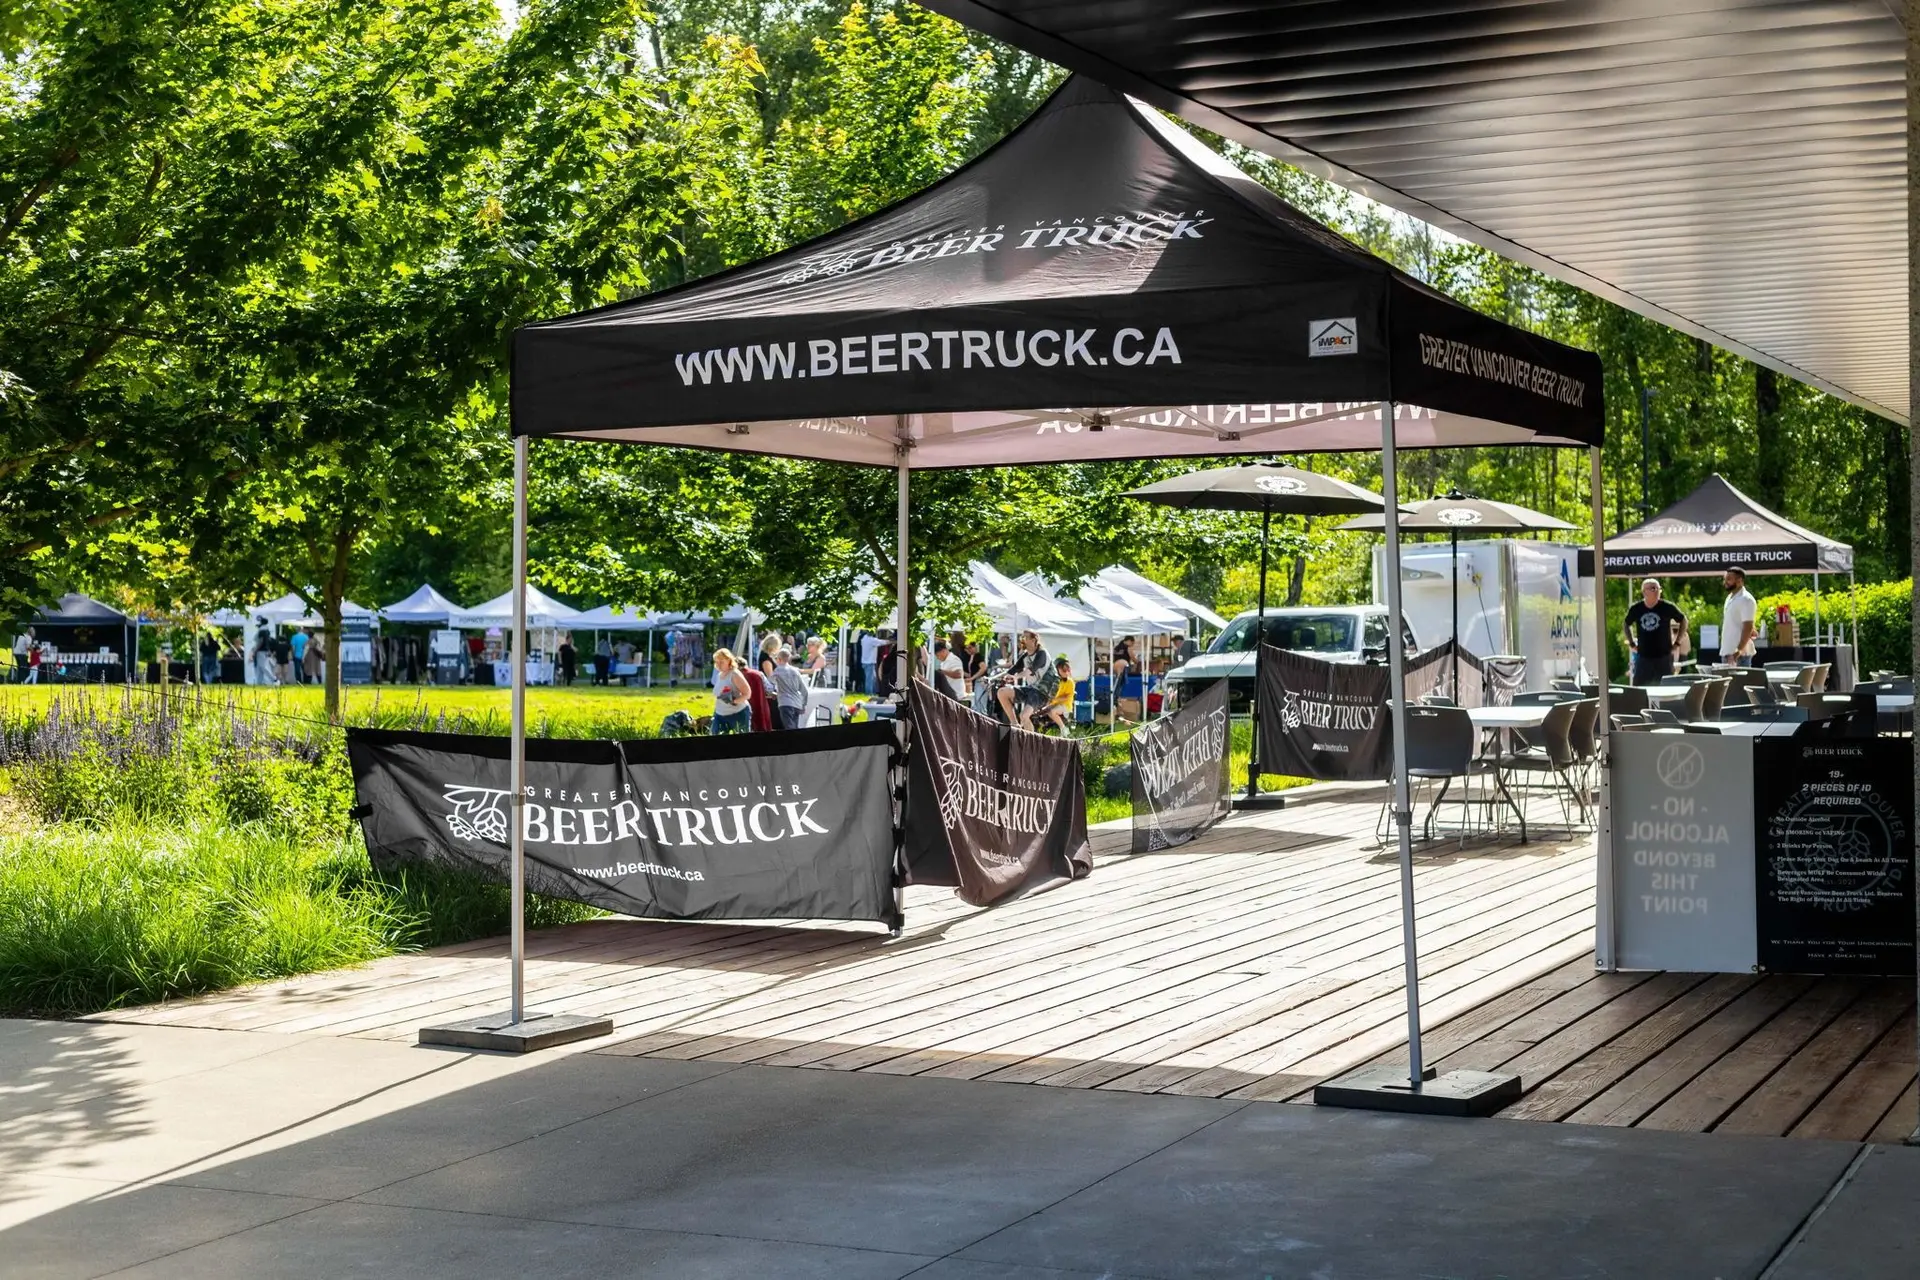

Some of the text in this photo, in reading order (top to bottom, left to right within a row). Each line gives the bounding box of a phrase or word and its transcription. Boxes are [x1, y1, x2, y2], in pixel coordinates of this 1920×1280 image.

[1035, 210, 1204, 227] VANCOUVER
[867, 217, 1215, 268] BEER TRUCK
[675, 327, 1182, 386] WWW.BEERTRUCK.CA
[1419, 333, 1585, 408] GREATER VANCOUVER BEER TRUCK
[1604, 551, 1792, 567] GREATER VANCOUVER BEER TRUCK
[1301, 700, 1332, 729] BEER
[1836, 748, 1864, 756] TRUCK
[1828, 770, 1844, 779] 19+
[526, 783, 802, 803] GREATER VANCOUVER
[1011, 777, 1050, 793] ANCOUVER
[1802, 783, 1872, 793] 2 PIECES OF ID
[1813, 796, 1862, 807] REQUIRED
[522, 798, 829, 846] BEER TRUCK
[573, 861, 705, 881] www.beertruck.ca
